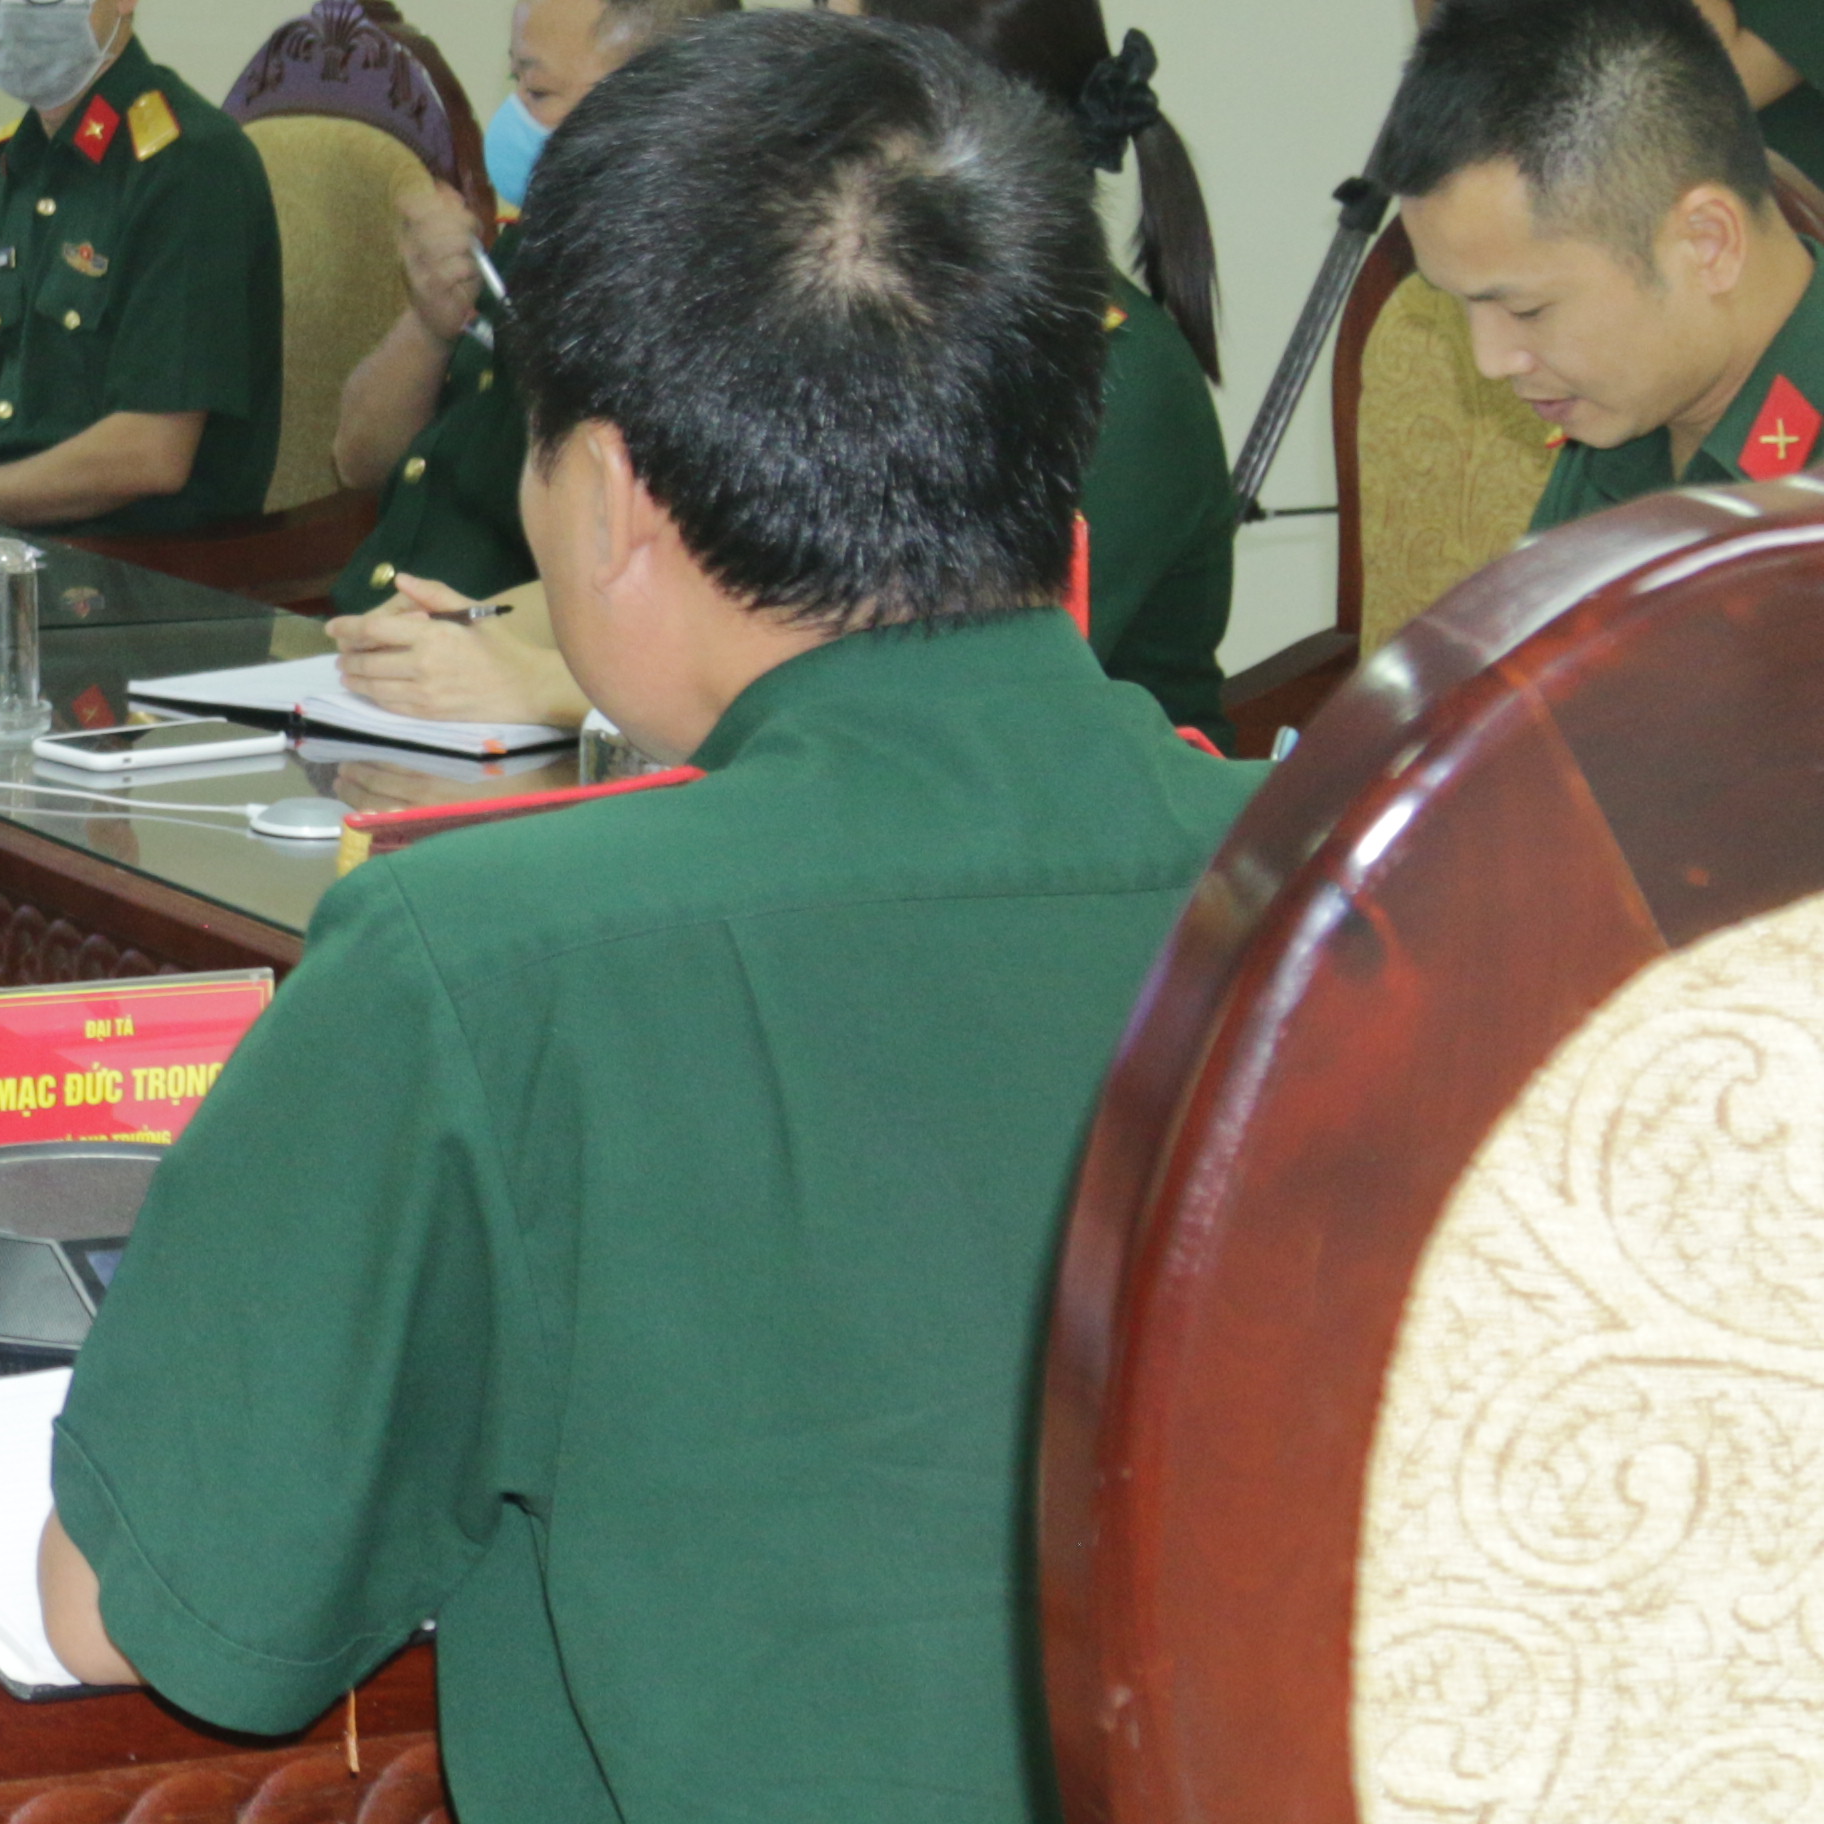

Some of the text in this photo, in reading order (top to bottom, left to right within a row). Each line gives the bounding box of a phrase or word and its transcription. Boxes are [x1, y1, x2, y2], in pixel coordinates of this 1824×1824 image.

[85, 1014, 134, 1042] ĐẠI TÁ
[64, 1062, 123, 1106] ĐỨC
